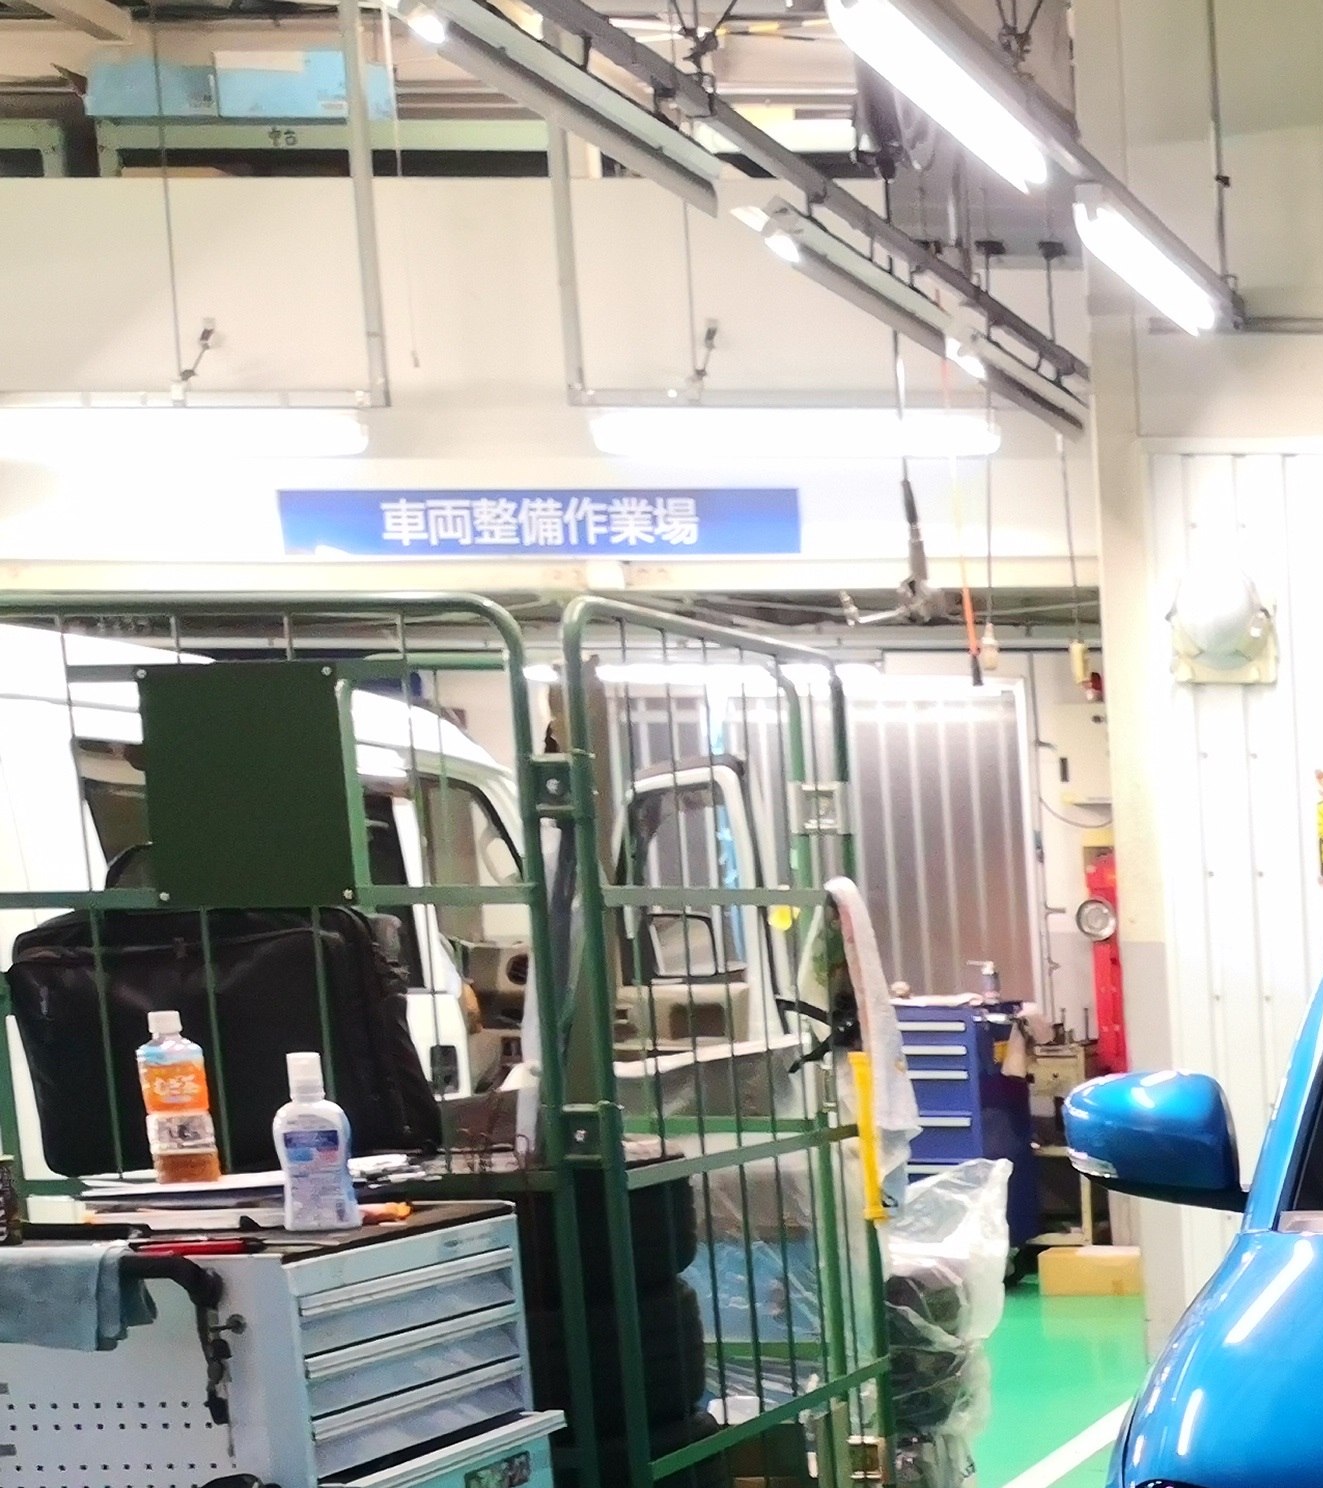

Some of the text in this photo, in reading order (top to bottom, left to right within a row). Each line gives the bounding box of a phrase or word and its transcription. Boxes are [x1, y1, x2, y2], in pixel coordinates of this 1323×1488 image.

[380, 497, 699, 546] 車両整備作業場
